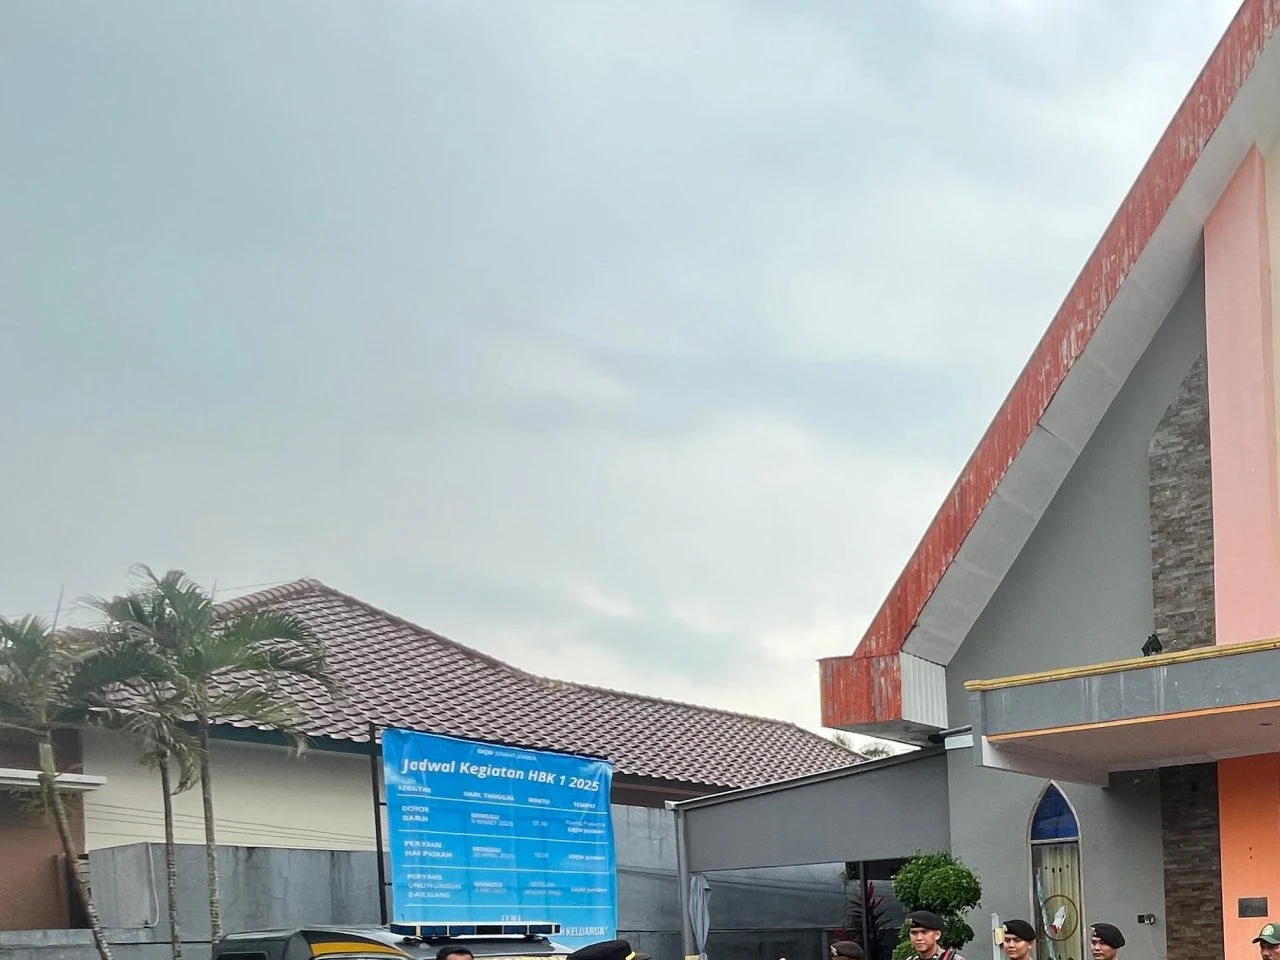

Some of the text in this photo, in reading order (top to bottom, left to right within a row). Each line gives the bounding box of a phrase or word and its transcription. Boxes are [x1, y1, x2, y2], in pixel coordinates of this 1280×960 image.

[401, 758, 600, 792] Jadwal Kegiatan HBK 1 2025
